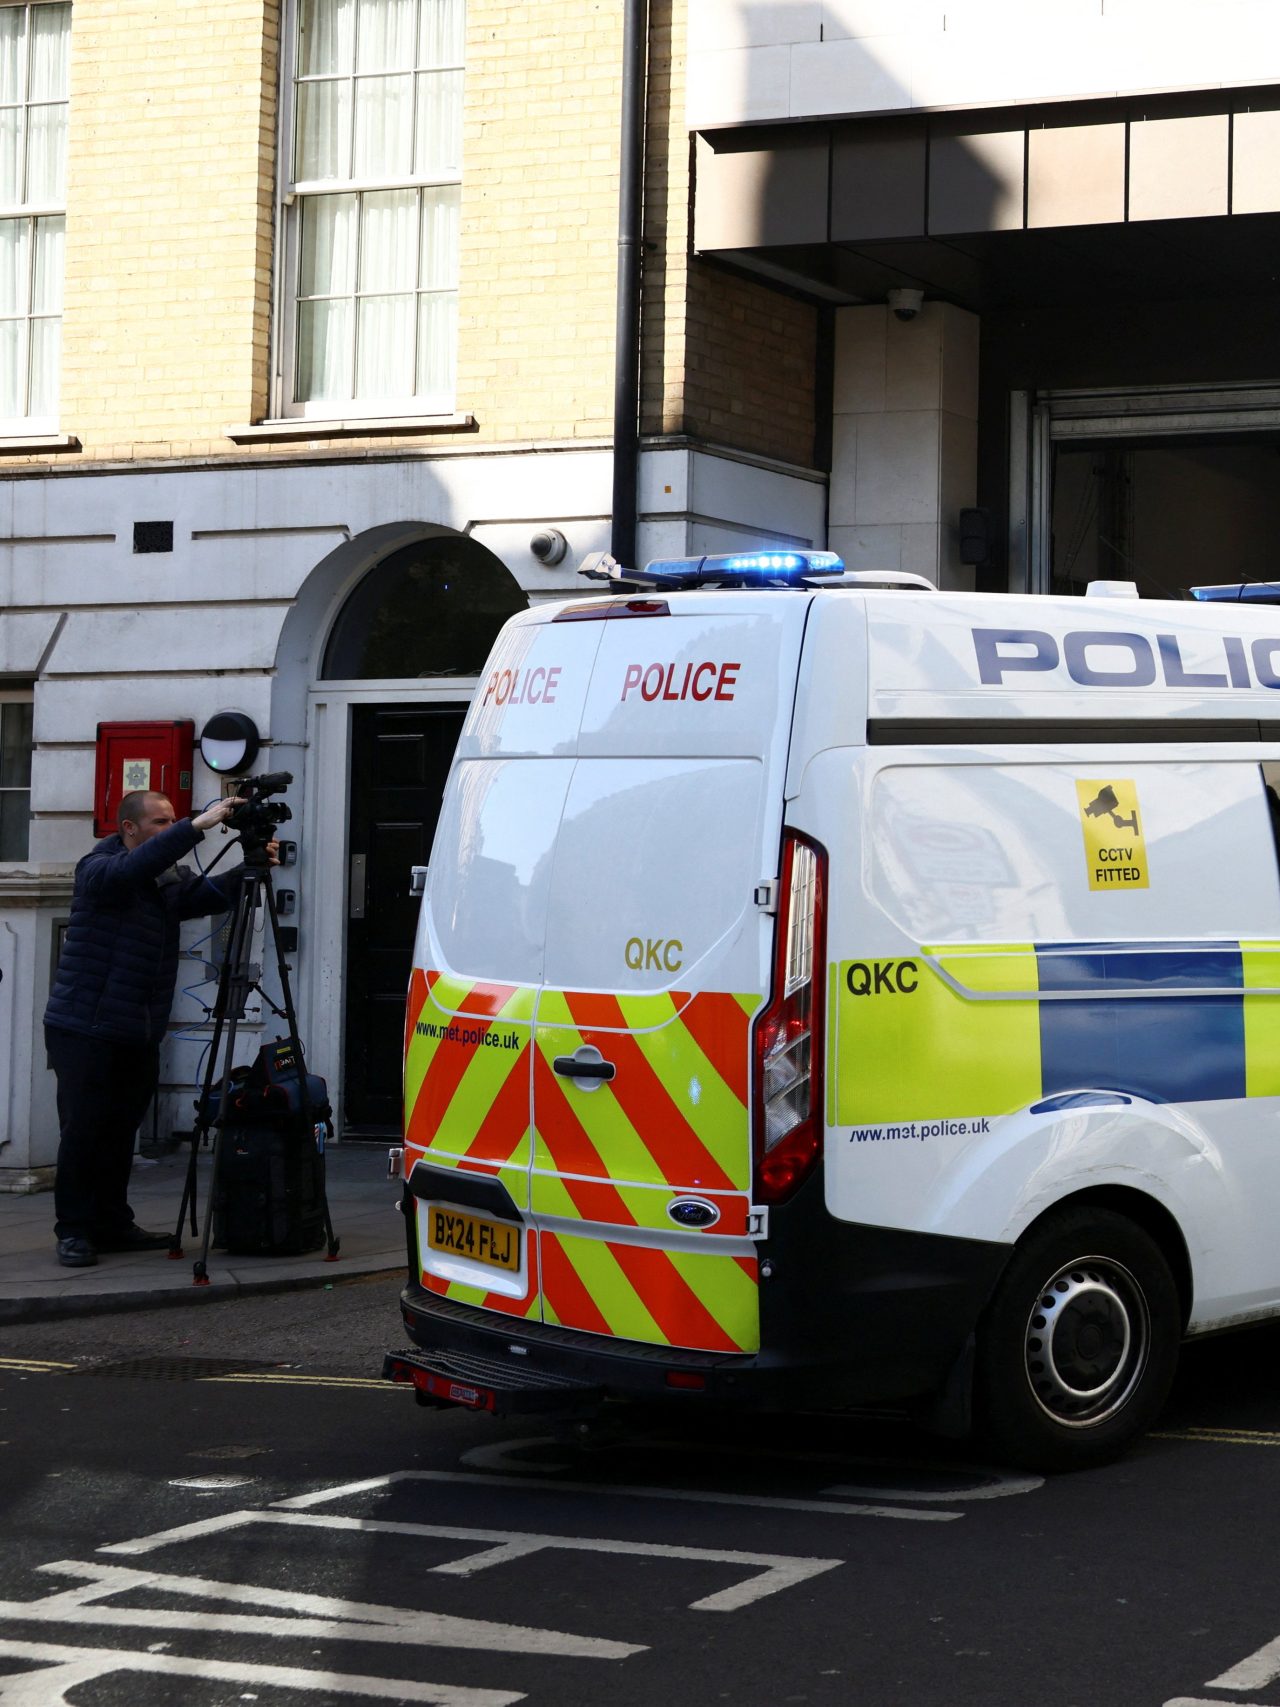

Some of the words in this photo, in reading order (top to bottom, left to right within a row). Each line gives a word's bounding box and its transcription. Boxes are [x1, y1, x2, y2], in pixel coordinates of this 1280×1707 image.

[483, 666, 562, 706] POLICE
[621, 661, 741, 702] POLICE
[1098, 848, 1133, 862] CCTV
[1095, 867, 1141, 882] FITTED
[624, 937, 683, 972] QKC
[846, 960, 918, 996] QKC
[415, 1021, 519, 1050] www.met.police.uk
[434, 1212, 475, 1253] BX24
[479, 1224, 511, 1264] FLJ
